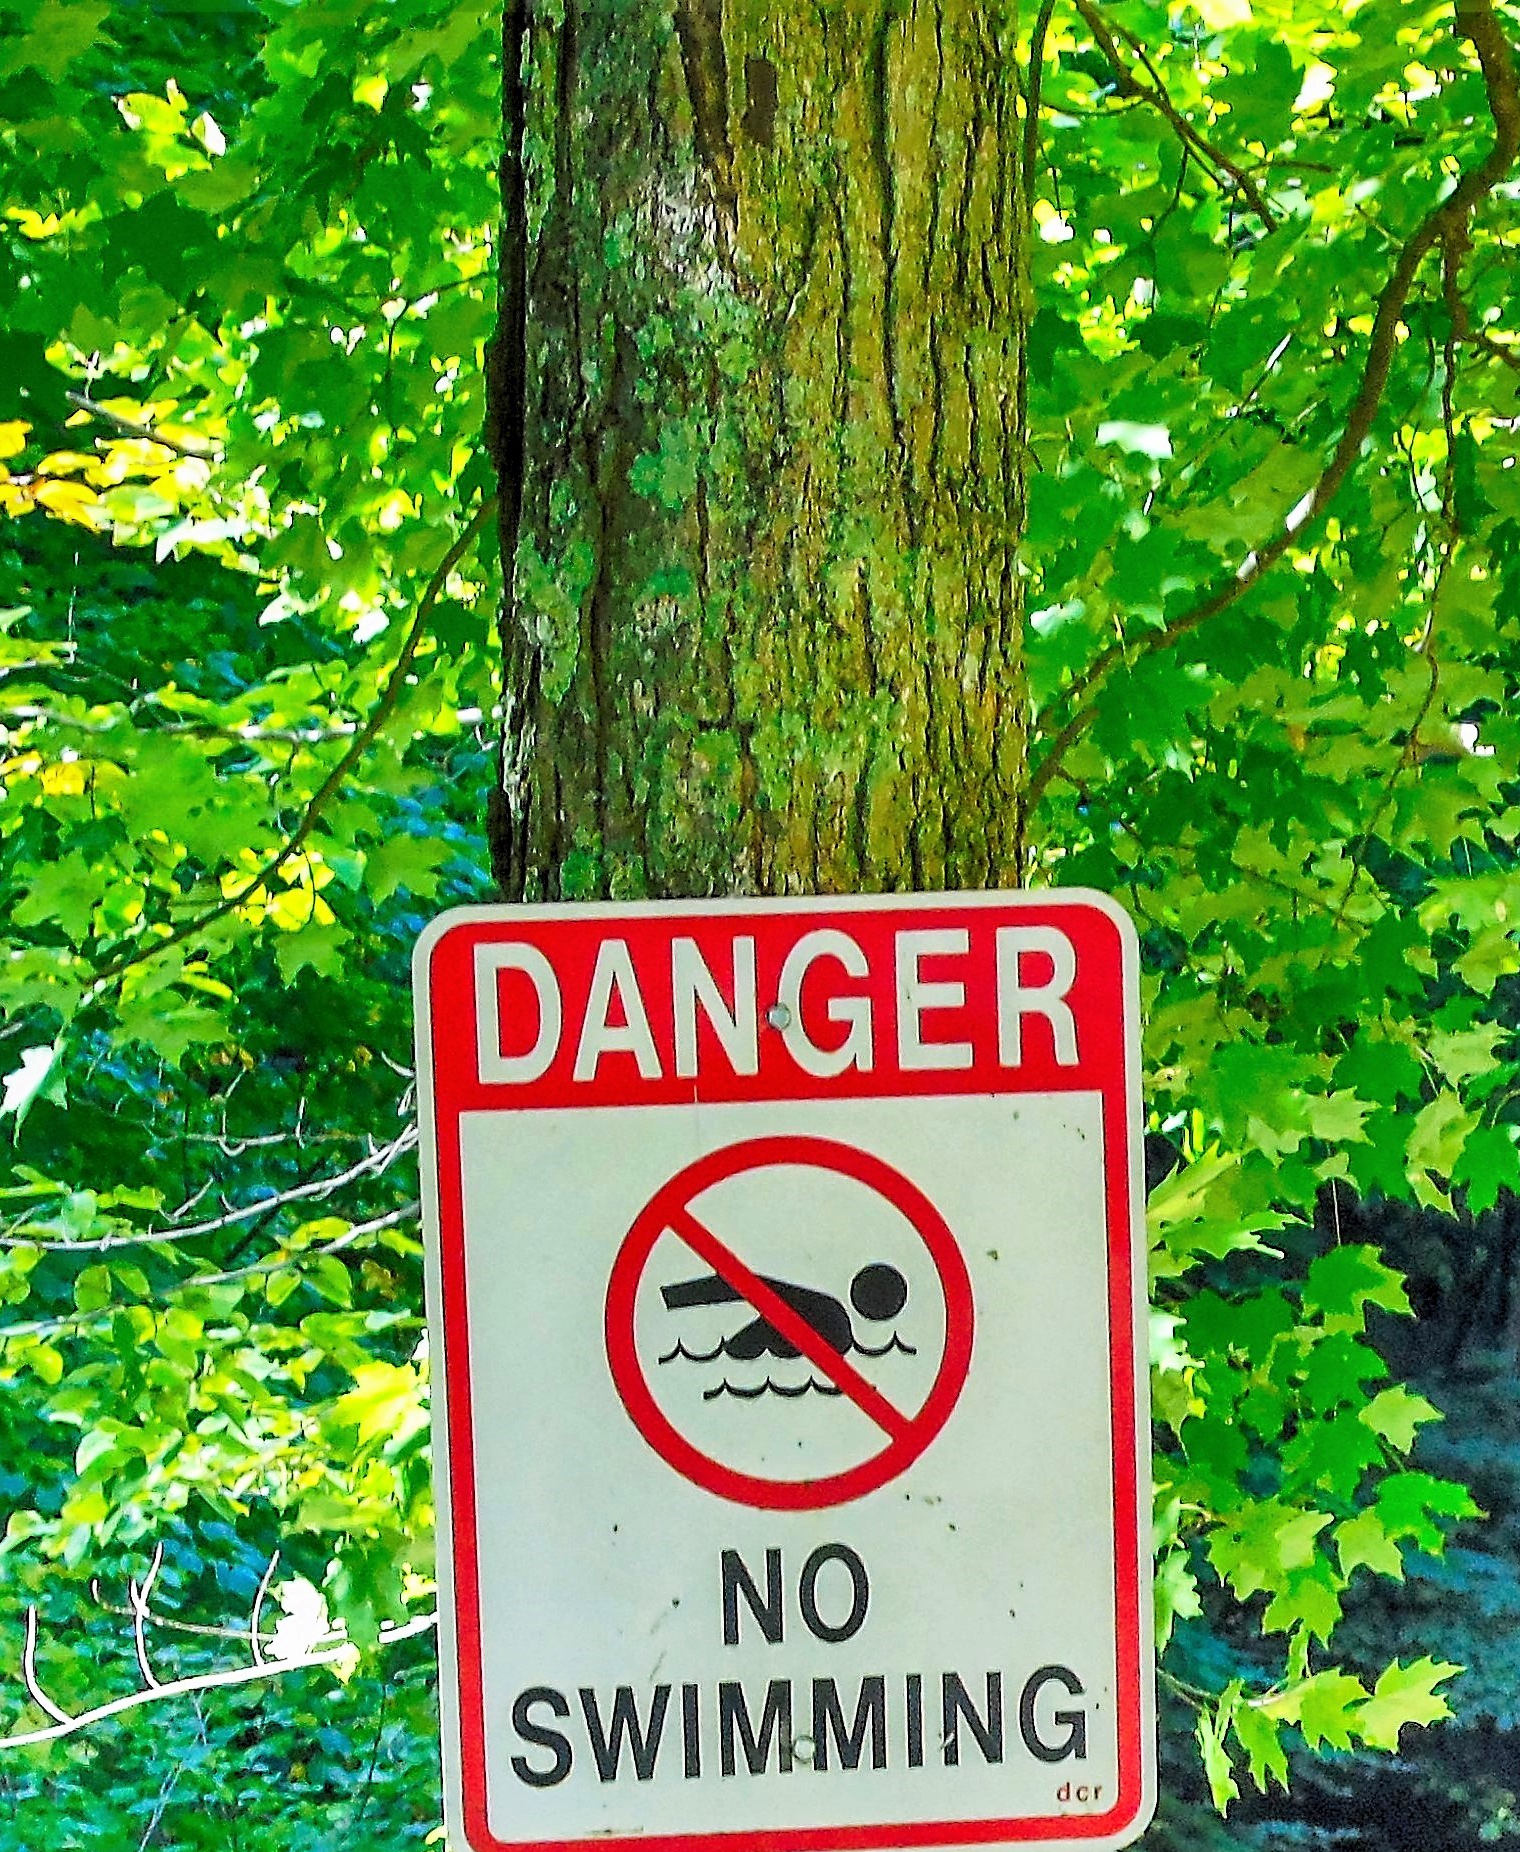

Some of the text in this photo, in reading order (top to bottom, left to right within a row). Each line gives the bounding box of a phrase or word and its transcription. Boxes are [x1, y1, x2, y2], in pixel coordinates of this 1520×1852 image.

[473, 925, 1079, 1085] DANGER
[721, 1542, 869, 1646] NO
[510, 1664, 1087, 1788] SWIMMING
[1056, 1781, 1103, 1802] dcr
